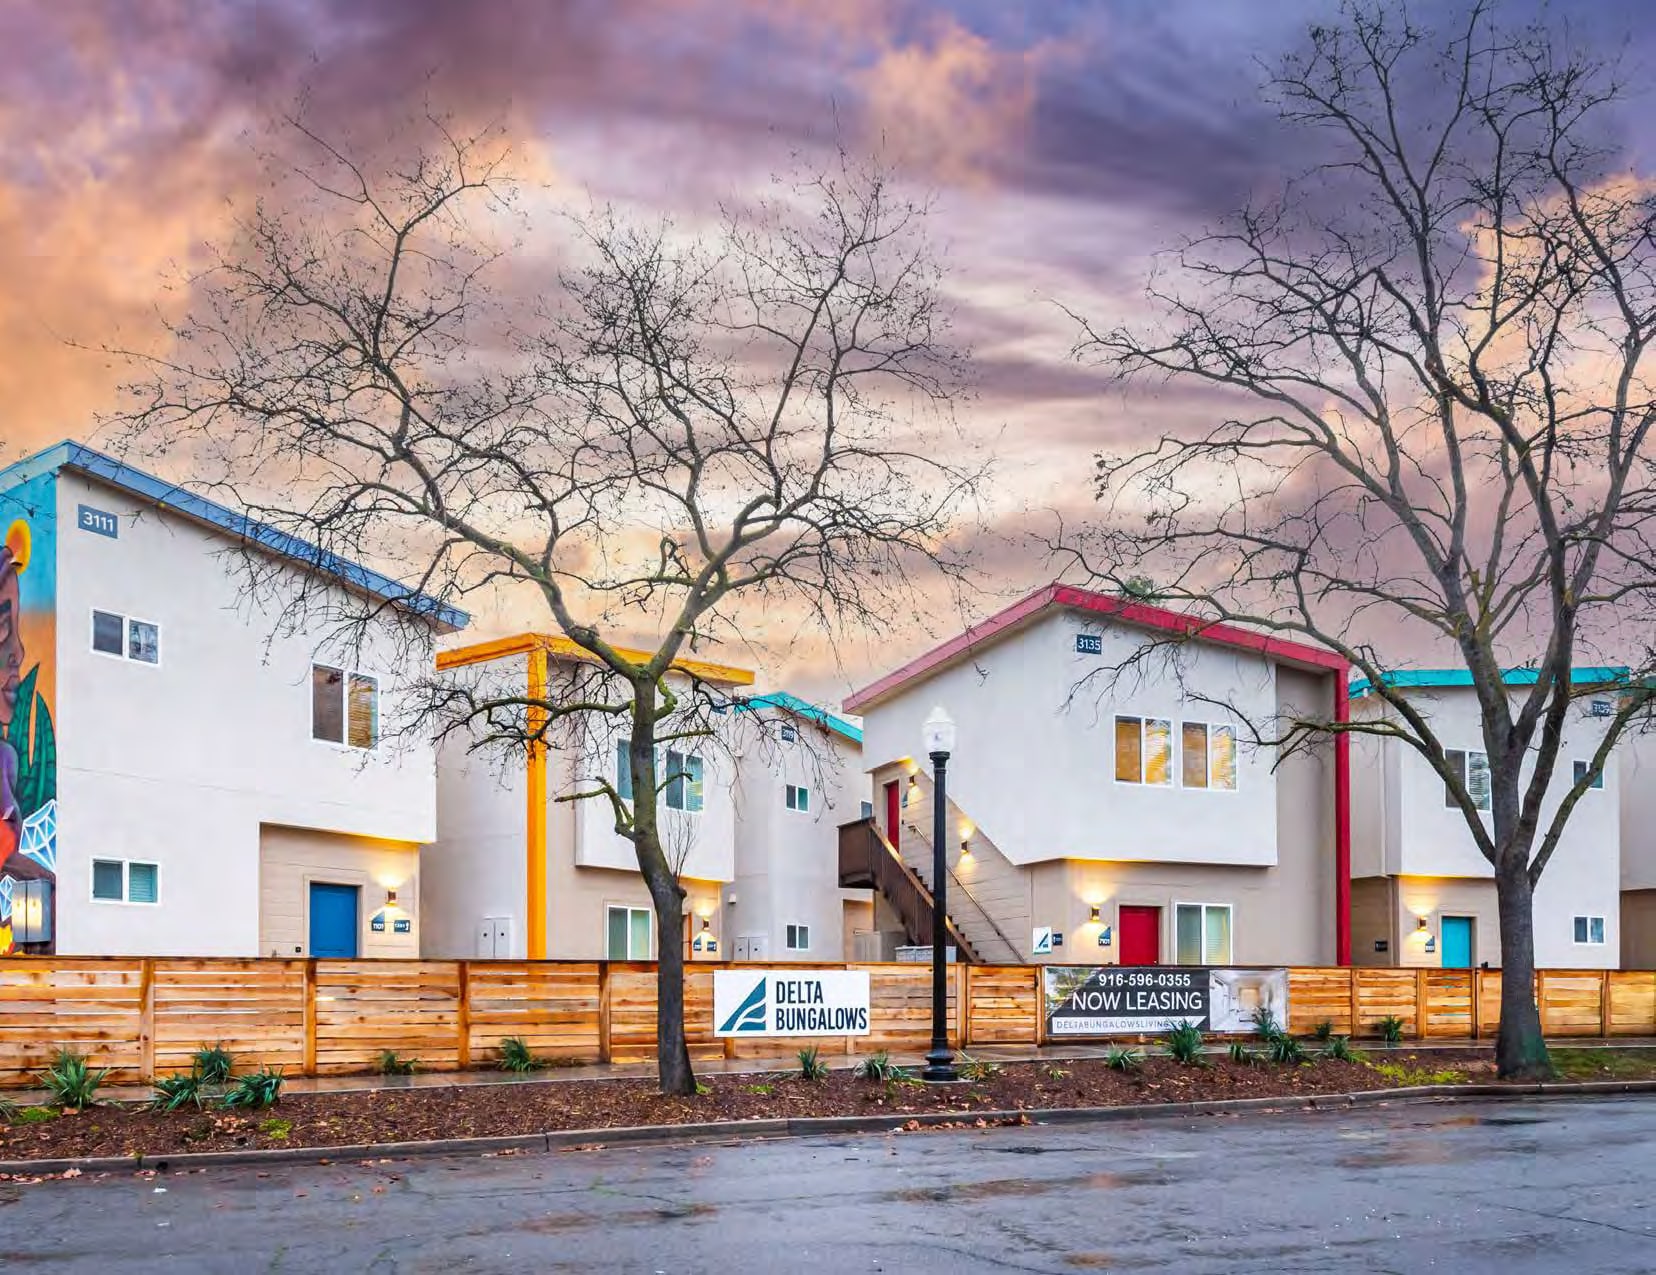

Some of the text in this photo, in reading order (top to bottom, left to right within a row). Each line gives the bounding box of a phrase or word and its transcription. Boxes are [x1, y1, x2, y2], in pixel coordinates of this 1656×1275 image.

[83, 511, 113, 533] 3111
[1078, 638, 1101, 651] 3135
[1099, 973, 1191, 986] 916-596-0355
[776, 981, 824, 1004] DELTA
[1072, 991, 1203, 1011] NOW LEASING
[776, 1007, 868, 1031] BUNGALOWS
